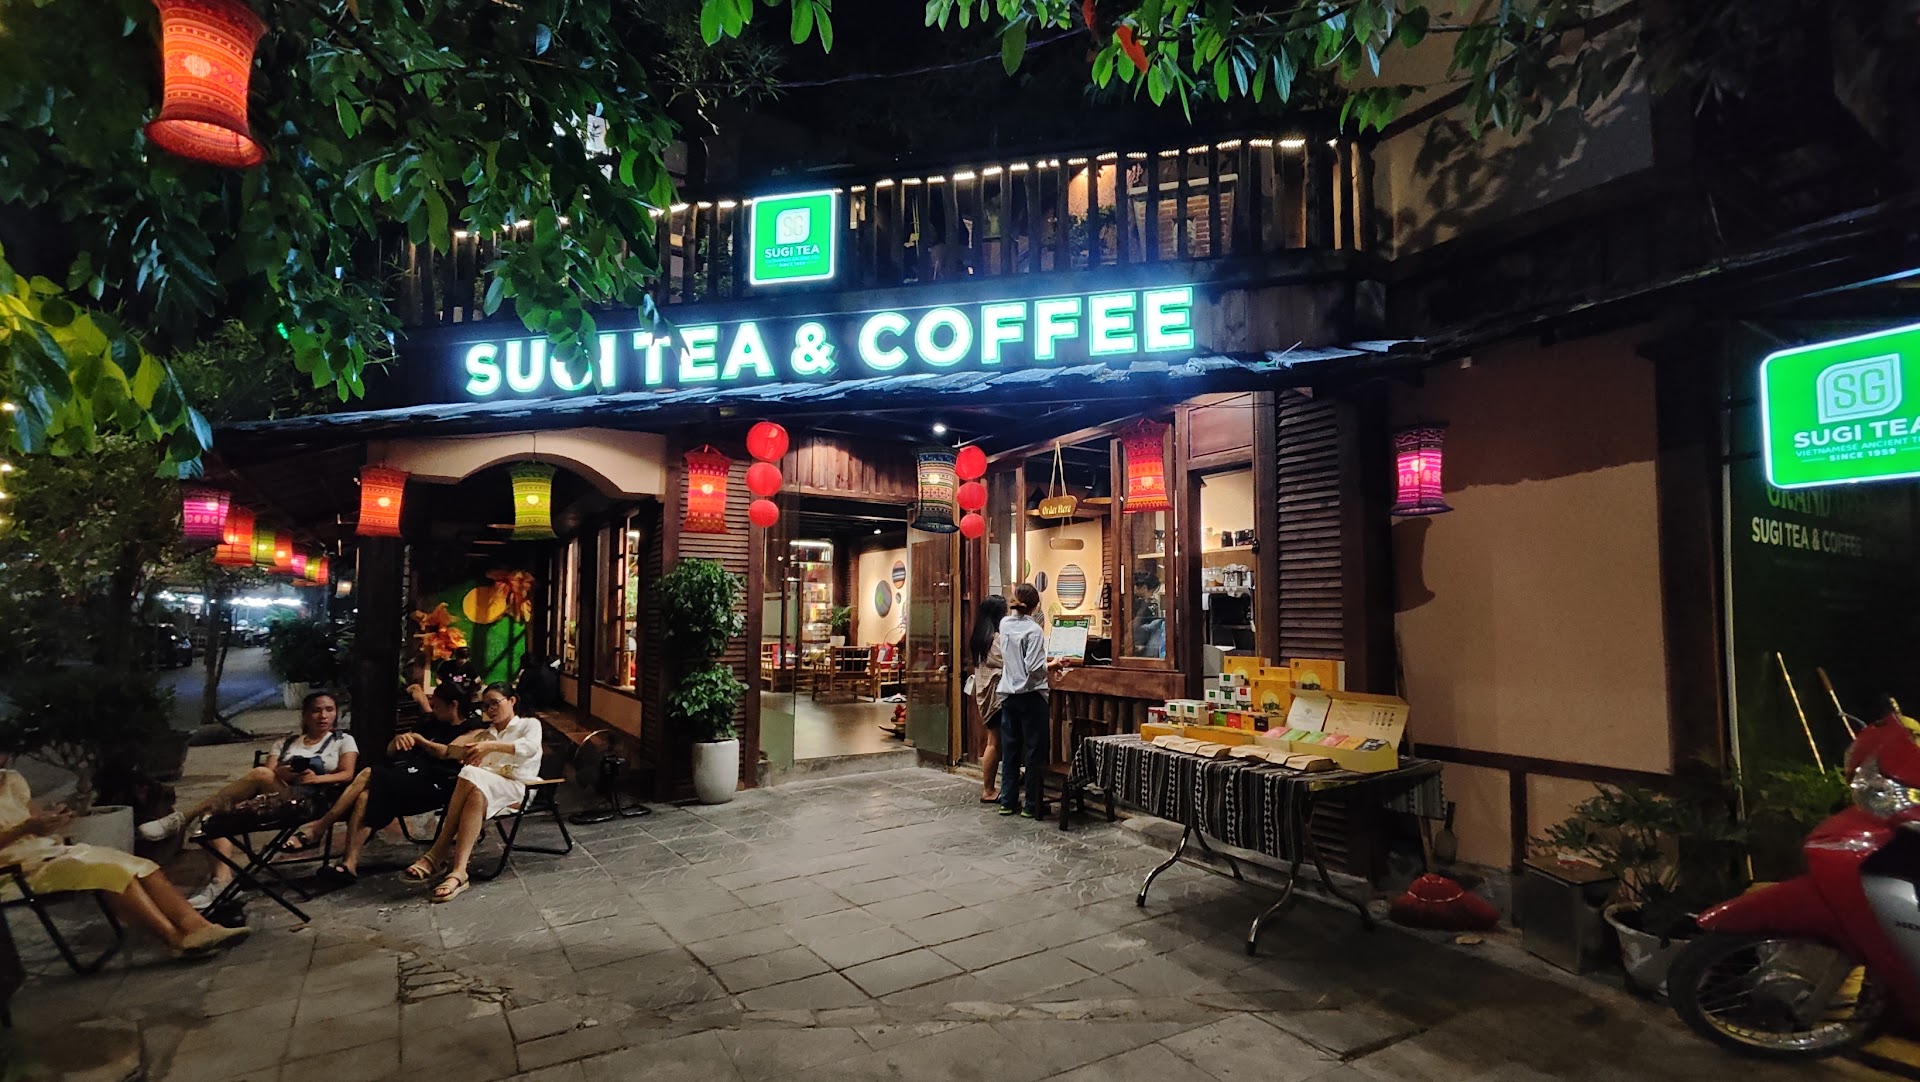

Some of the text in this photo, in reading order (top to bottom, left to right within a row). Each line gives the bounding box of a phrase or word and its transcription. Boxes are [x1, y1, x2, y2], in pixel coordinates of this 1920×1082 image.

[764, 244, 820, 258] SUGI TEA
[633, 321, 776, 385] TEA
[790, 321, 836, 376] &
[858, 286, 1194, 371] COFFEE
[1833, 368, 1886, 409] SG
[1793, 424, 1862, 449] SUGI
[1795, 443, 1859, 457] VIETNAMESE
[1861, 437, 1908, 450] ANCIENT
[1828, 451, 1864, 462] SINCE
[1751, 516, 1783, 546] SUGI
[1784, 522, 1810, 550] TEA
[1811, 528, 1820, 551] &
